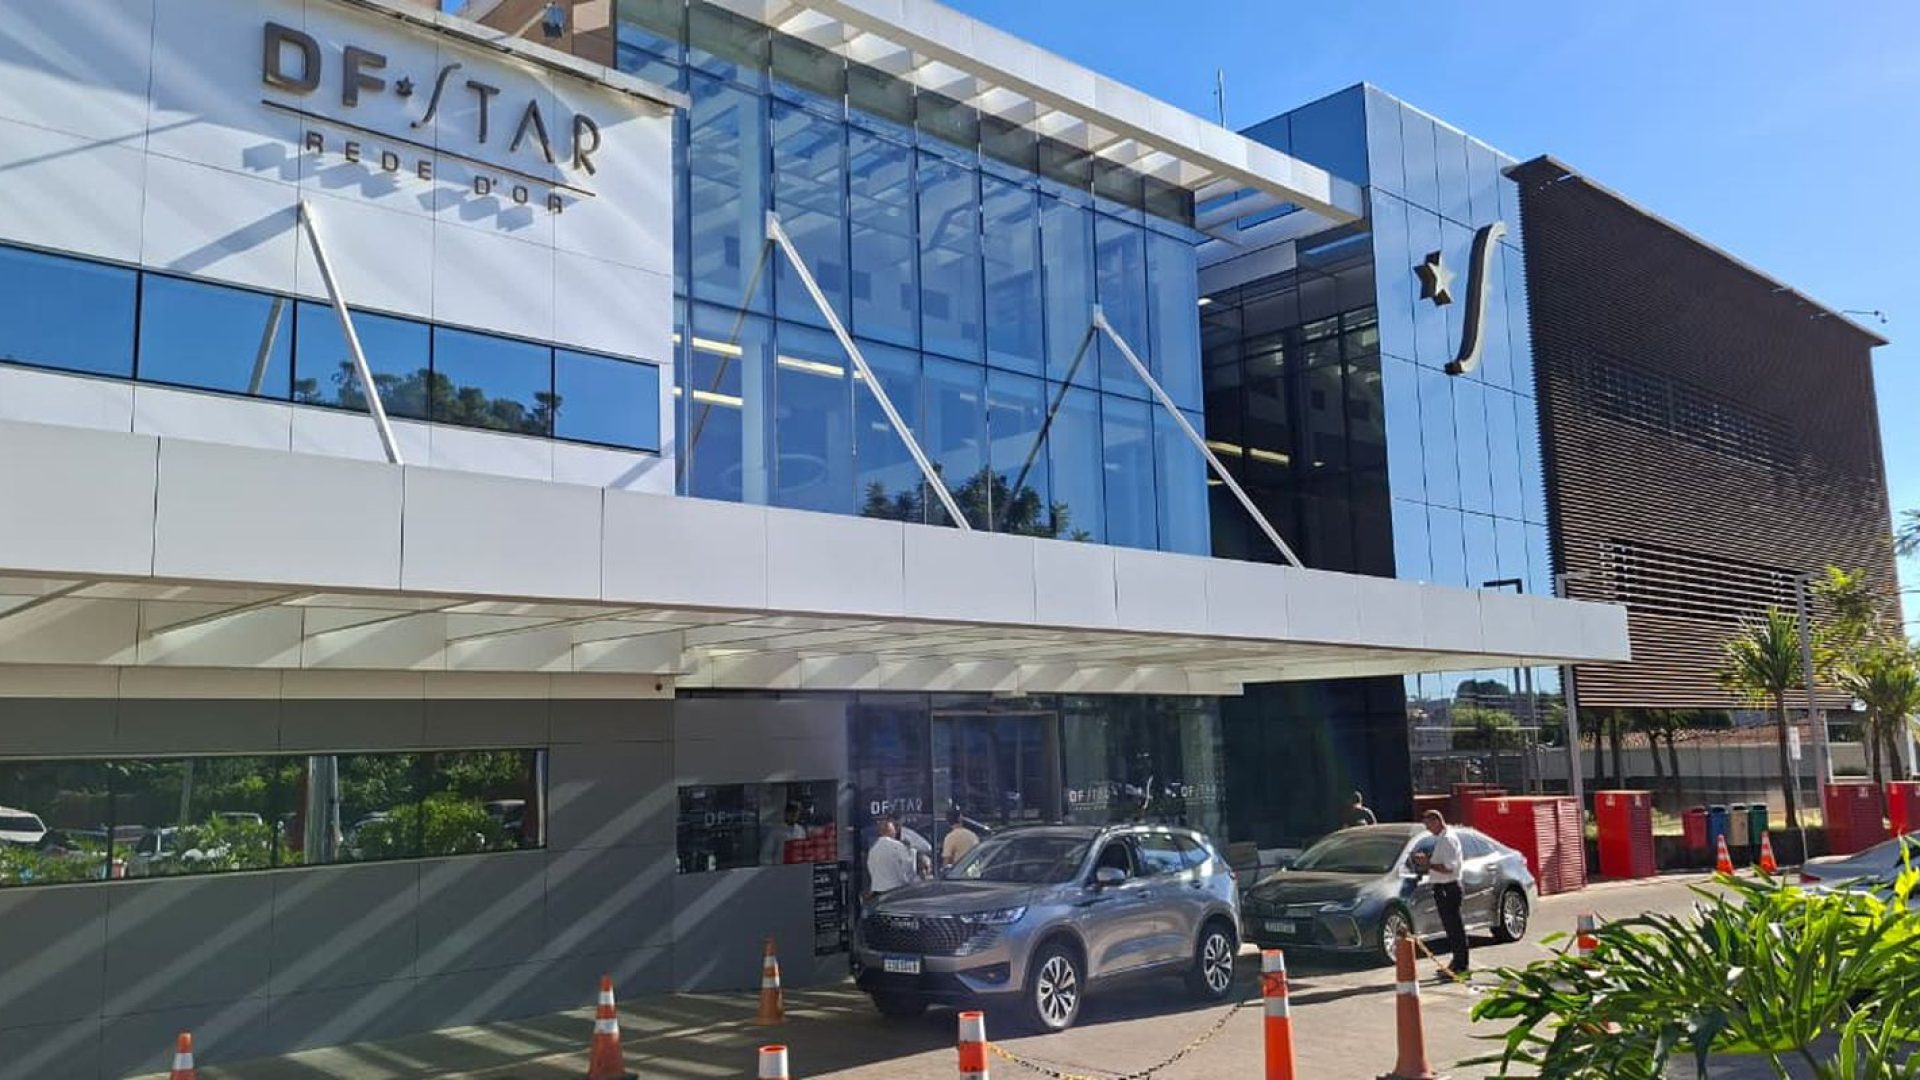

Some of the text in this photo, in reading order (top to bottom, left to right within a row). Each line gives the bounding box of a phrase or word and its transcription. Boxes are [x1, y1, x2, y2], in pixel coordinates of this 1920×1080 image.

[263, 20, 387, 108] DF
[305, 130, 563, 214] REDE D'OR
